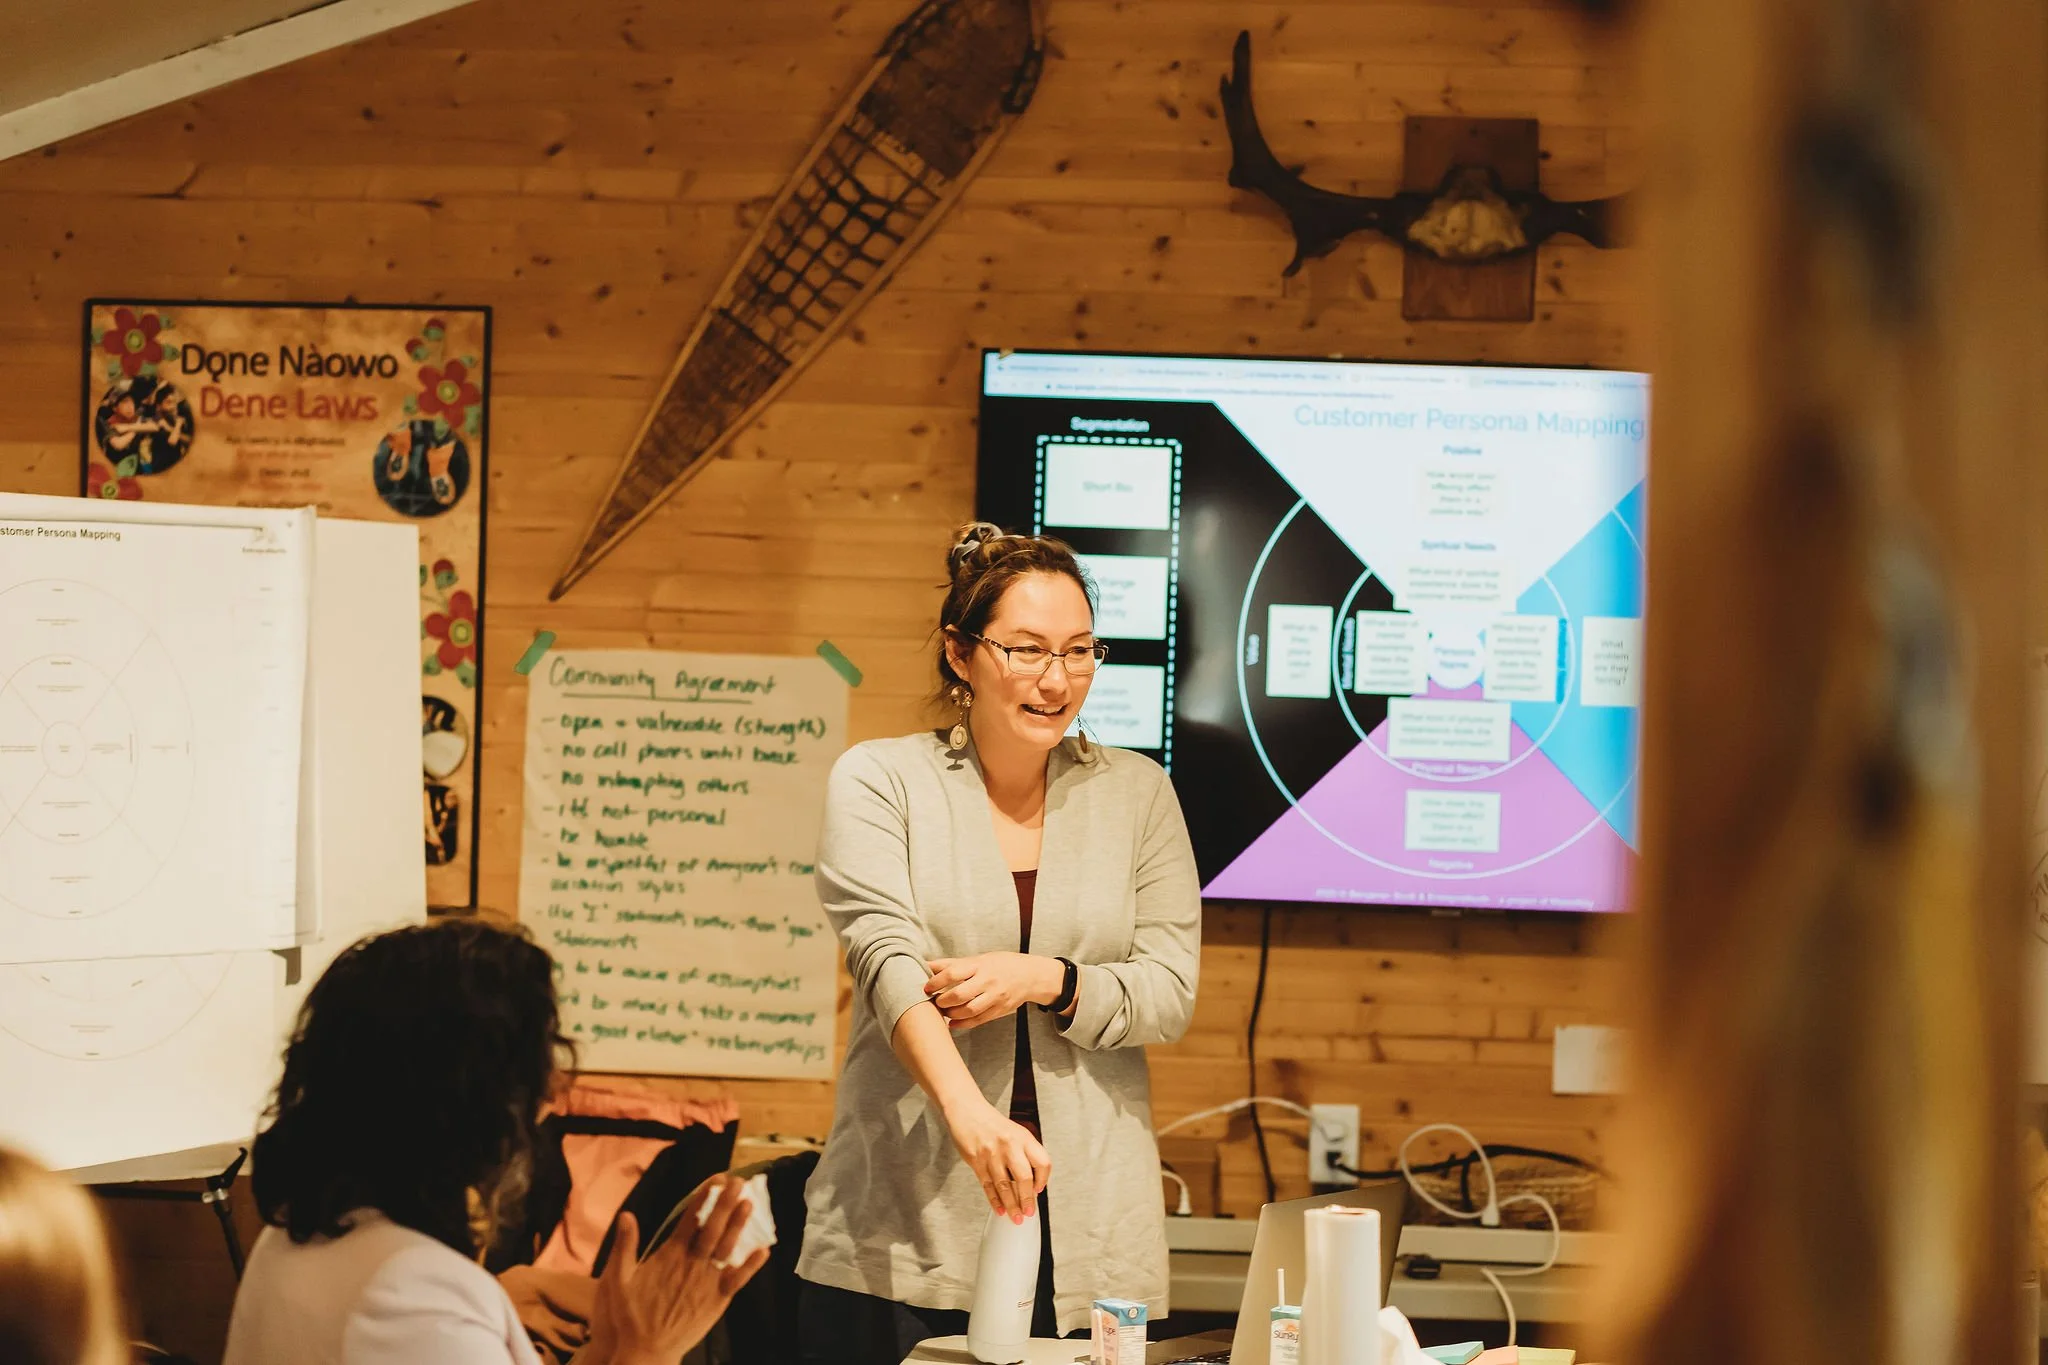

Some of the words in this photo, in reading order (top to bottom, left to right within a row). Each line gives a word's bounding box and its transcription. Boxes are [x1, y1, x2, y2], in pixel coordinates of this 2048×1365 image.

[280, 343, 399, 379] Nàowo
[200, 386, 288, 420] Dene
[297, 388, 379, 422] Laws
[1294, 403, 1418, 429] Customer
[1427, 406, 1529, 433] Persona
[1537, 410, 1645, 441] Mapping
[0, 527, 34, 537] stomer
[37, 527, 76, 538] Persona
[80, 528, 121, 541] Mapping
[561, 714, 603, 737] open
[562, 743, 586, 757] no
[593, 742, 627, 759] cell
[701, 746, 742, 761] until
[562, 771, 584, 786] no
[696, 777, 749, 795] others
[602, 803, 639, 818] not
[647, 808, 726, 827] personal
